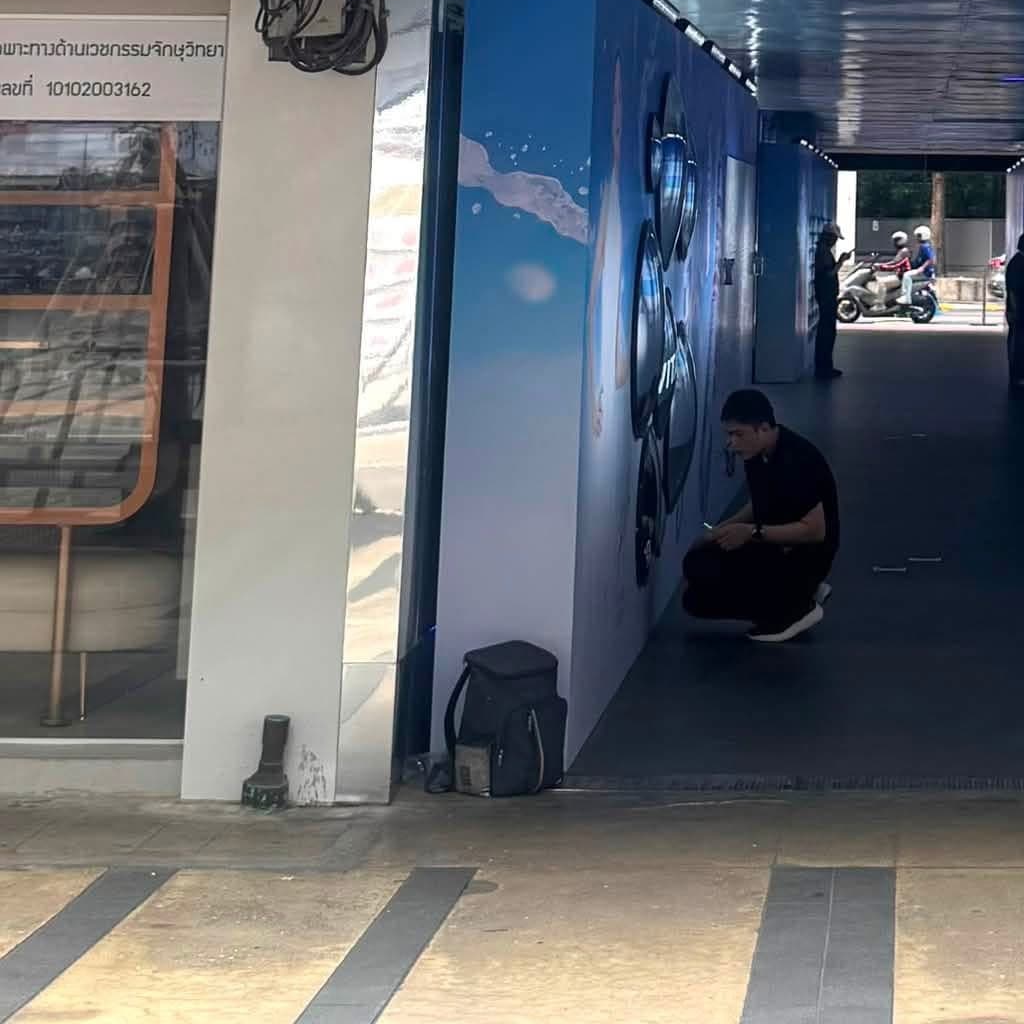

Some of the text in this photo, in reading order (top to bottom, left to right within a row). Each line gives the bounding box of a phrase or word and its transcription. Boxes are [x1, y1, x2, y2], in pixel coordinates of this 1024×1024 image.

[0, 38, 225, 62] พาะทางด้านเวชกรรมจักษุวิทยา
[46, 81, 152, 97] 10102003162
